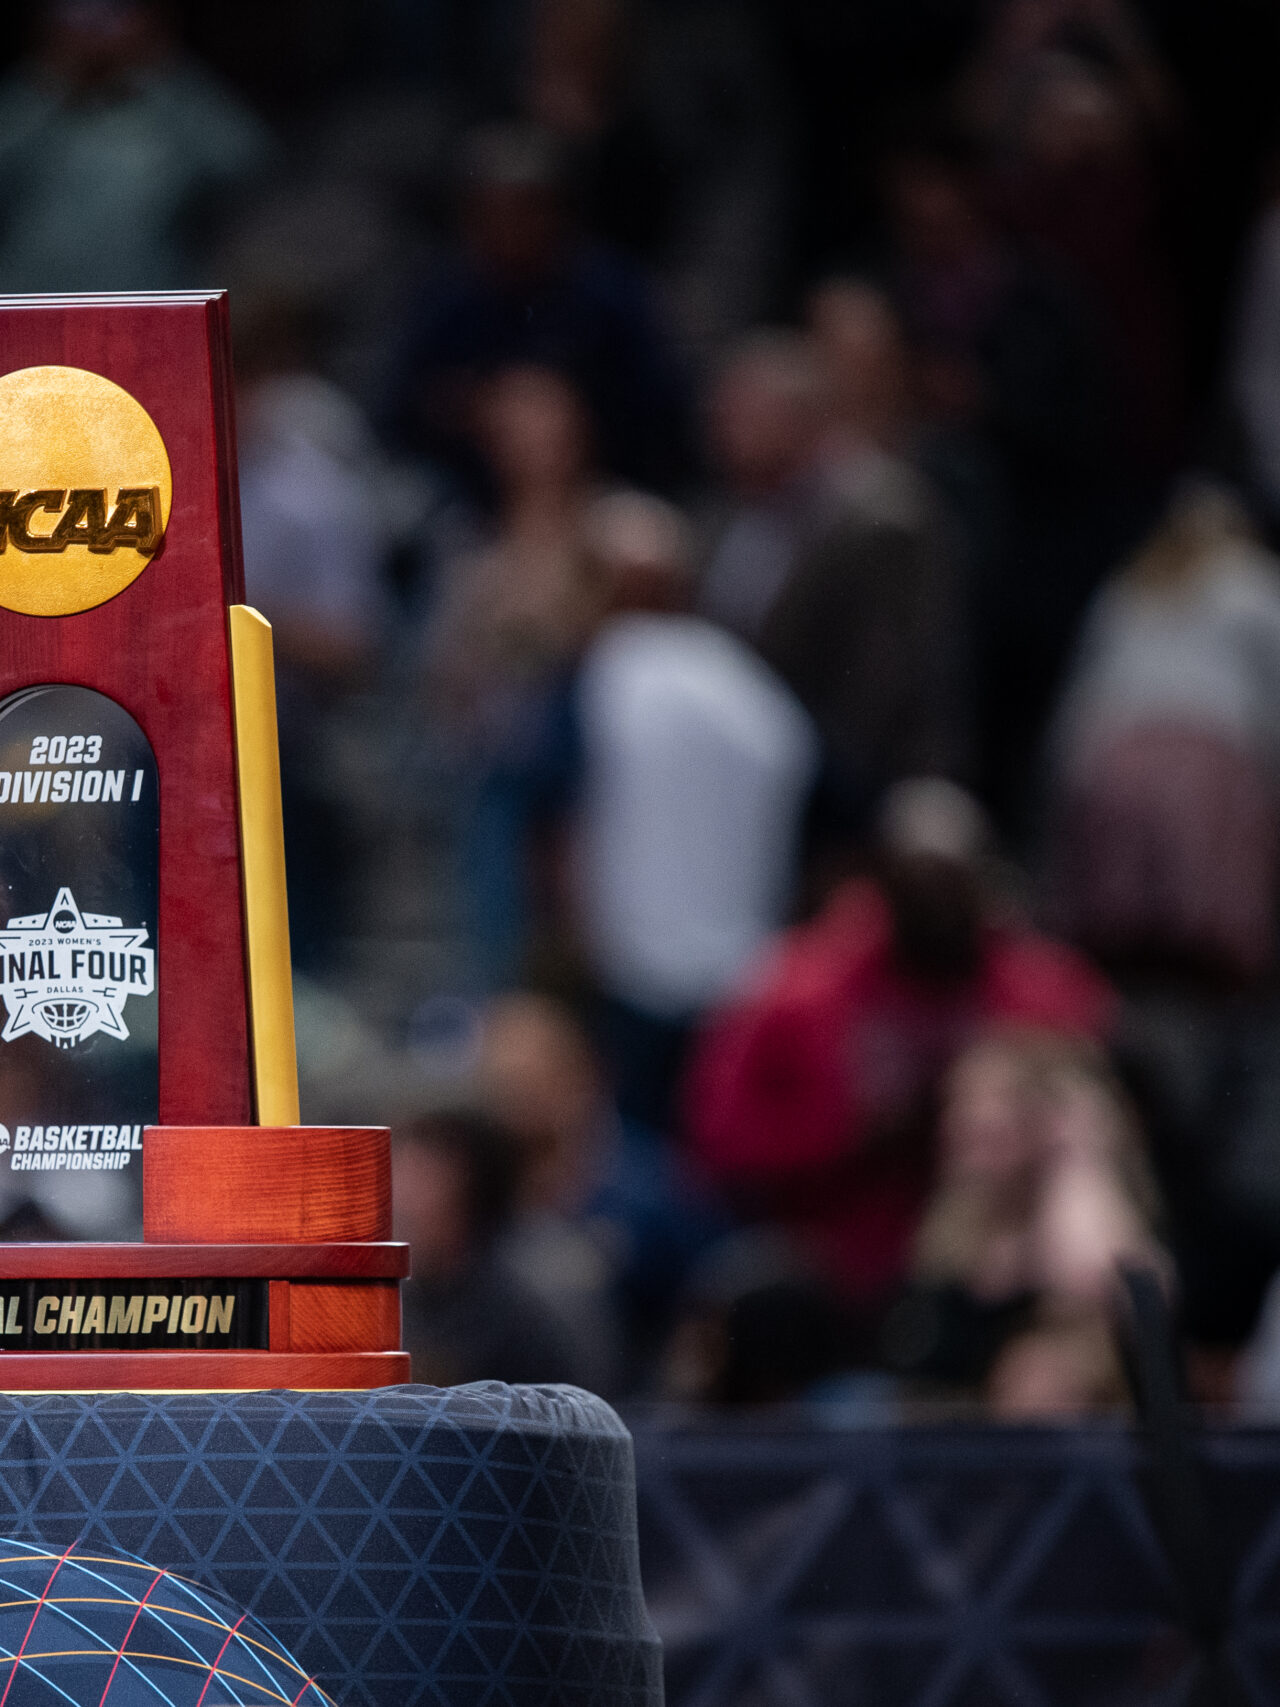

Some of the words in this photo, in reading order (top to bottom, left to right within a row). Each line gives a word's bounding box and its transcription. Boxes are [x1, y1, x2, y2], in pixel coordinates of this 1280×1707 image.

[29, 735, 103, 765] 2023
[131, 769, 144, 802] I
[28, 939, 53, 947] 2023
[58, 938, 102, 946] WOMEN'S
[71, 950, 148, 986] FOUR
[46, 986, 84, 994] DALLAS
[14, 1125, 146, 1151] BASKETBAL
[11, 1152, 131, 1171] CHAMPIONSHIP
[34, 1295, 235, 1334] CHAMPION
